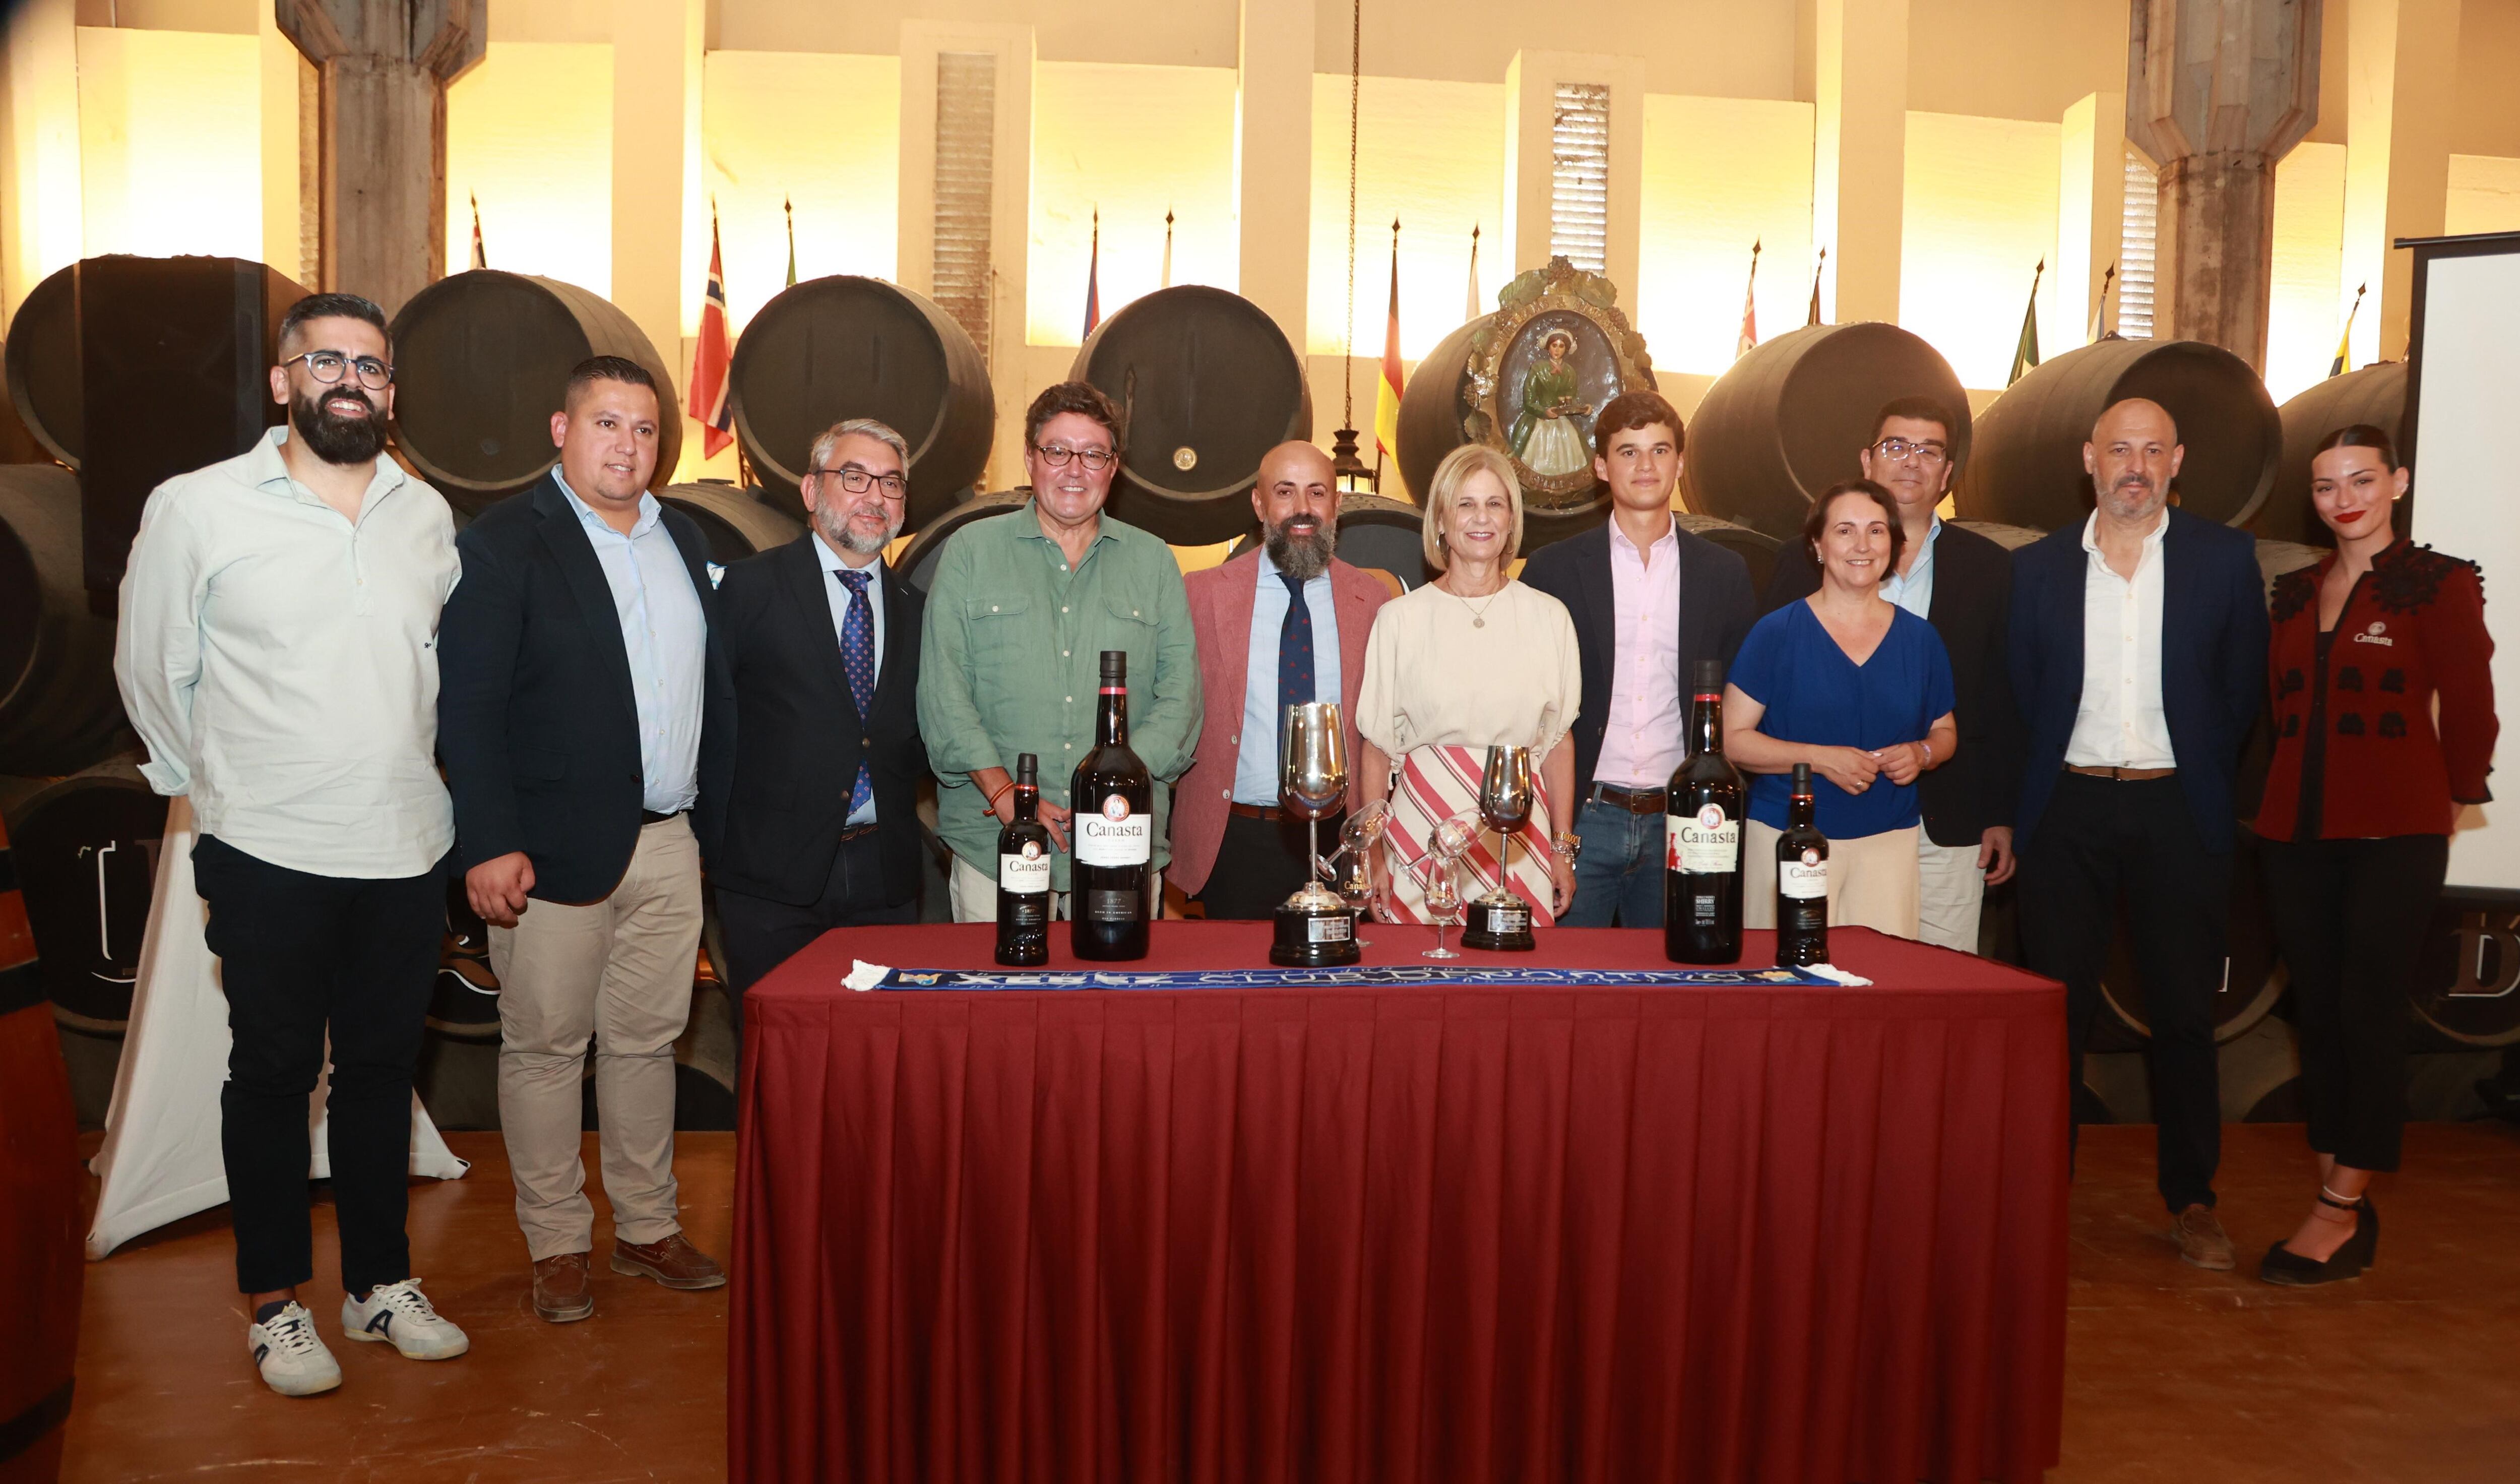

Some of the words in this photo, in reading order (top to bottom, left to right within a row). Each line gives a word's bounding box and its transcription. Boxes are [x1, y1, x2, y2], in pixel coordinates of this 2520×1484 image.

[2353, 633, 2393, 646] Canasta
[1086, 821, 1143, 837] Canasta
[1681, 827, 1736, 843] Canasta
[1010, 860, 1048, 872] Canasta
